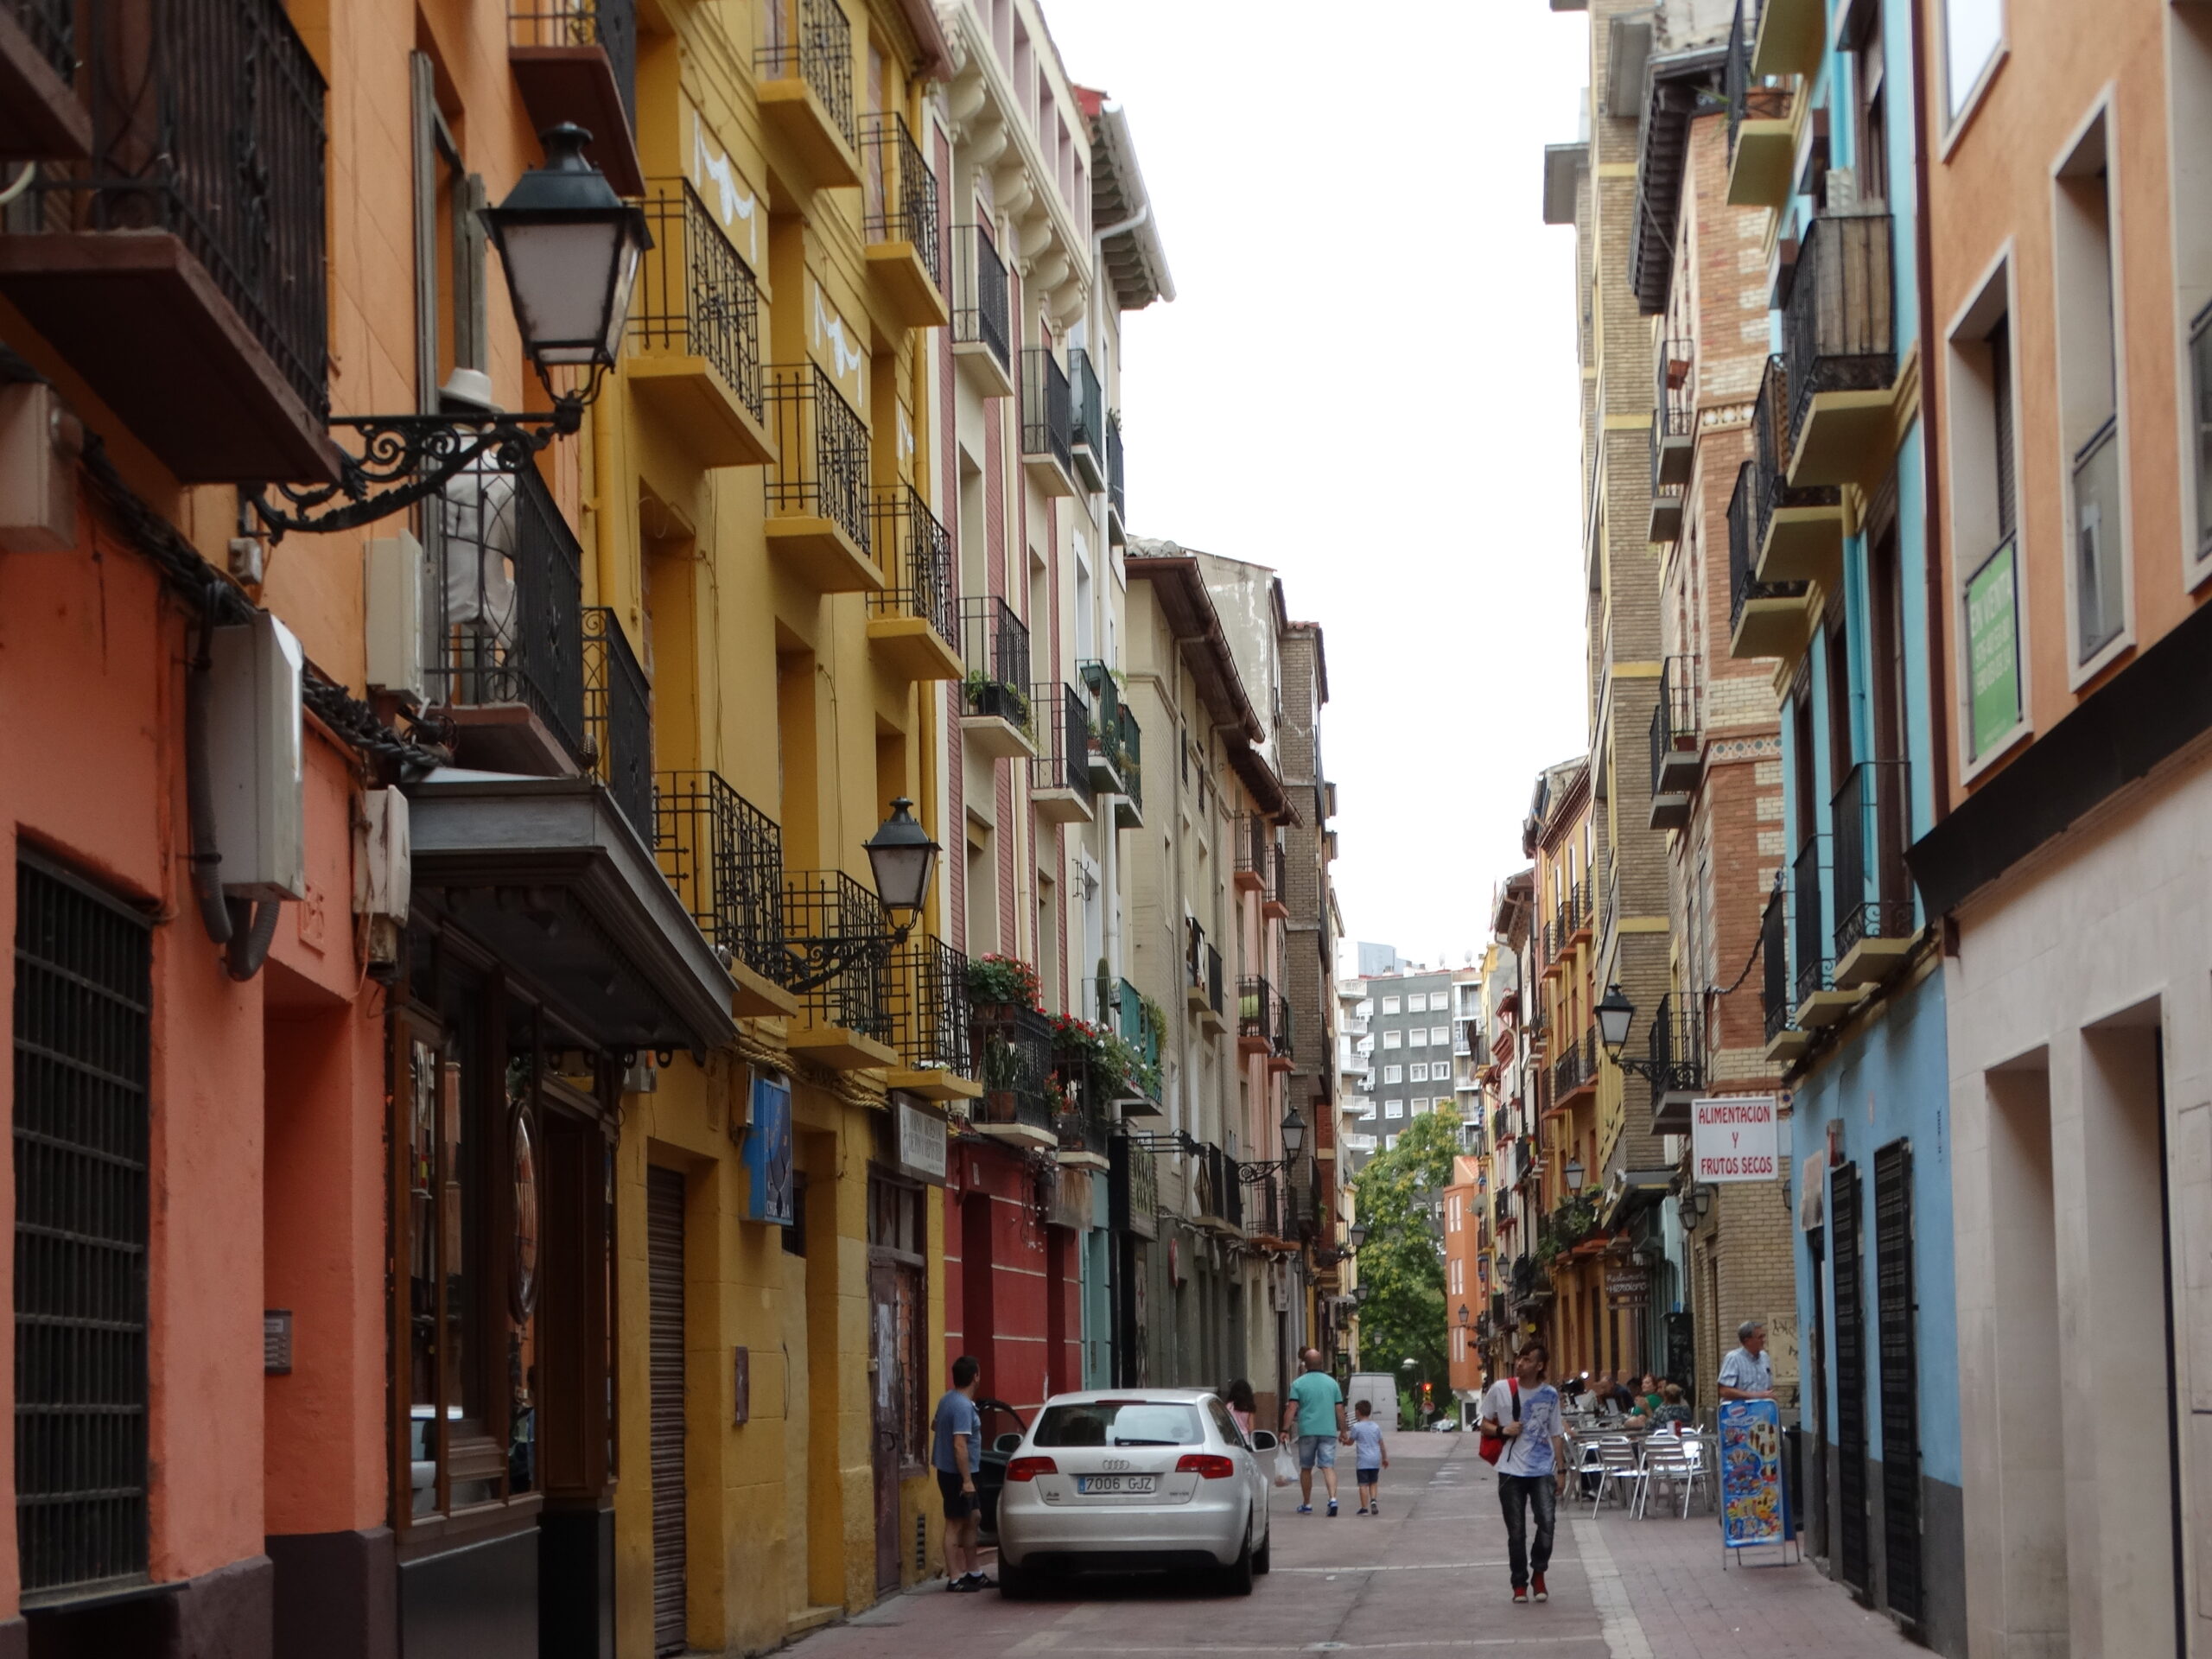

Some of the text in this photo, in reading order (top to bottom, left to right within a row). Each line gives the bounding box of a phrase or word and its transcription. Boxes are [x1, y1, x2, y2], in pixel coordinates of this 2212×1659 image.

[1699, 1106, 1770, 1124] ALIMENTACION
[1732, 1132, 1738, 1148] Y
[1700, 1157, 1772, 1175] FRUTOS SECOS
[1086, 1478, 1152, 1491] 7006 GJZ
